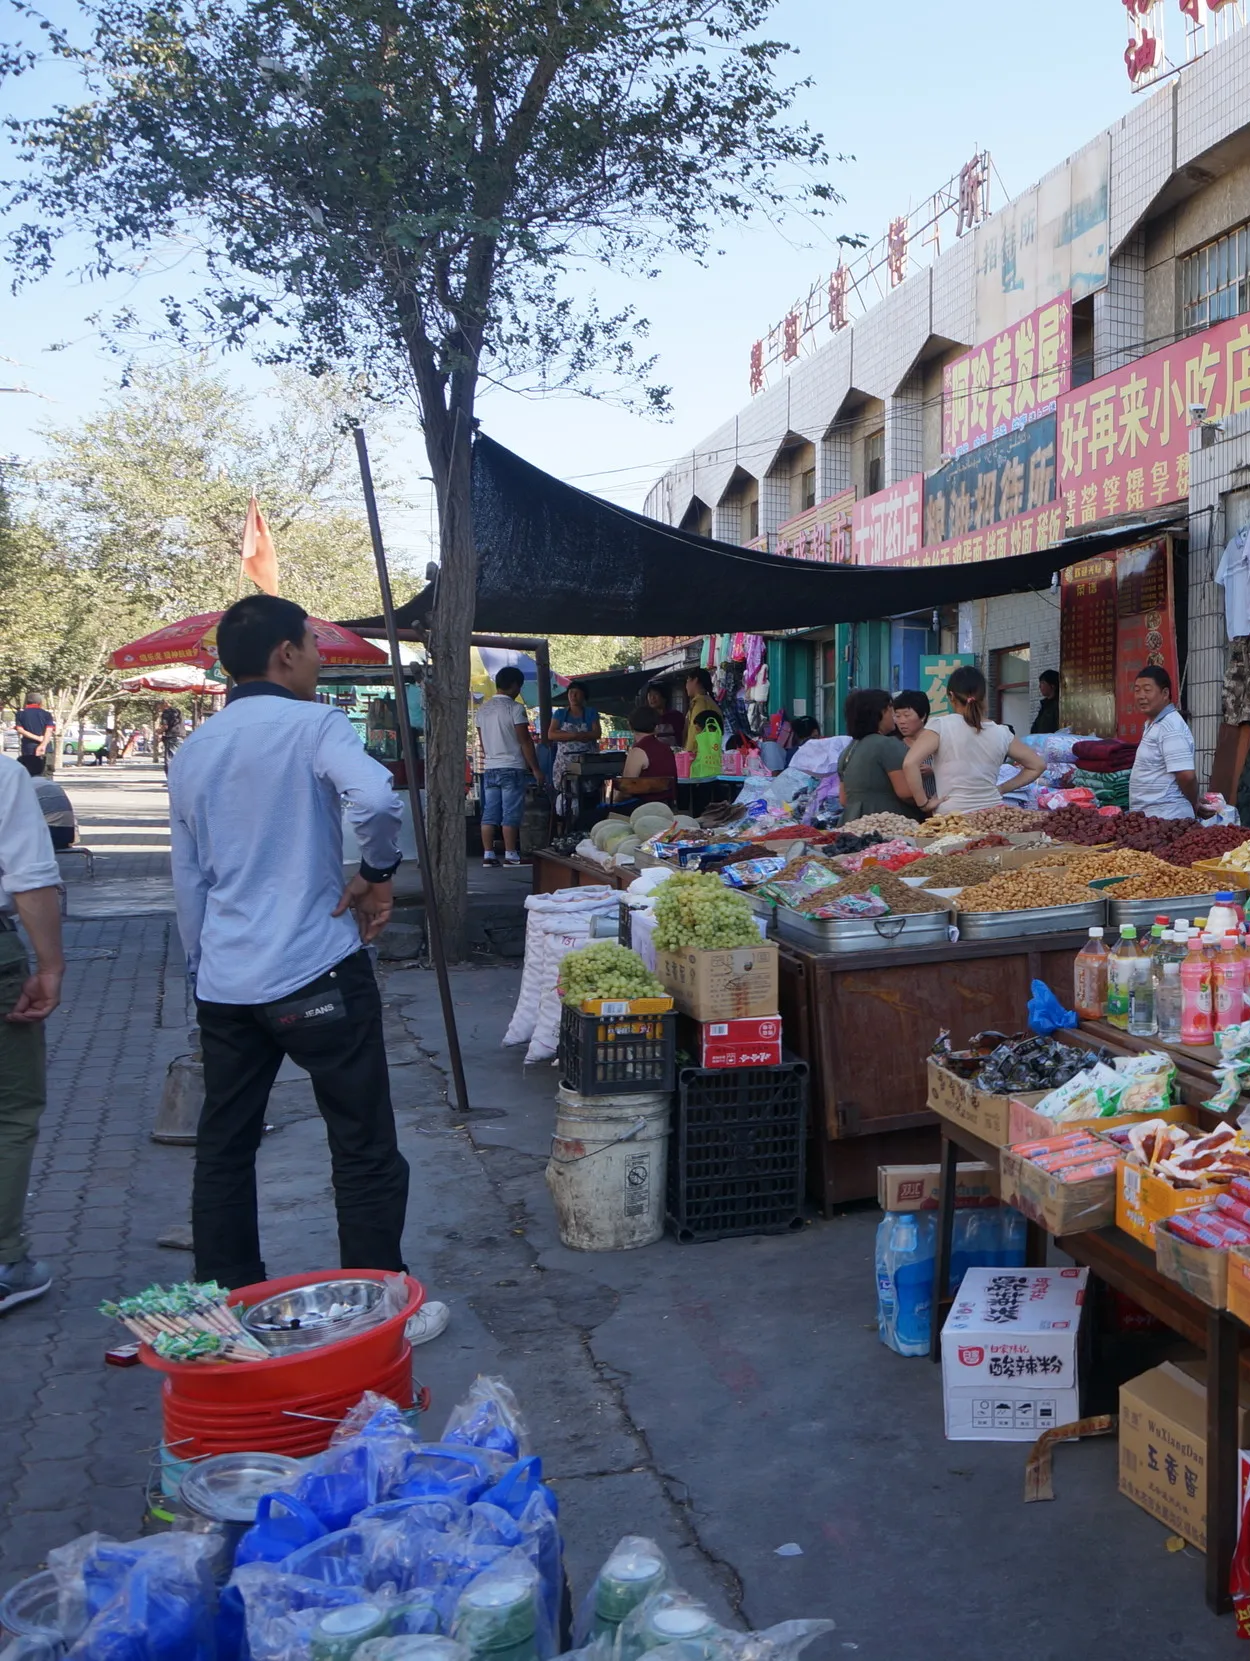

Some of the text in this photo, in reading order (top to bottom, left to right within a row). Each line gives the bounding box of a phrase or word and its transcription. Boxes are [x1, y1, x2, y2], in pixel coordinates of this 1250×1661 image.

[952, 303, 1060, 448] 阿玲美发屋
[1102, 475, 1120, 516] 饺子
[1126, 468, 1144, 511] 馄饨
[1151, 461, 1169, 504] 包子
[1081, 484, 1097, 525] 炒面
[303, 1003, 335, 1018] JEANS
[989, 1355, 1063, 1379] 酸辣粉
[1148, 1420, 1205, 1464] WuXiangDan
[1147, 1444, 1199, 1498] 五香蛋
